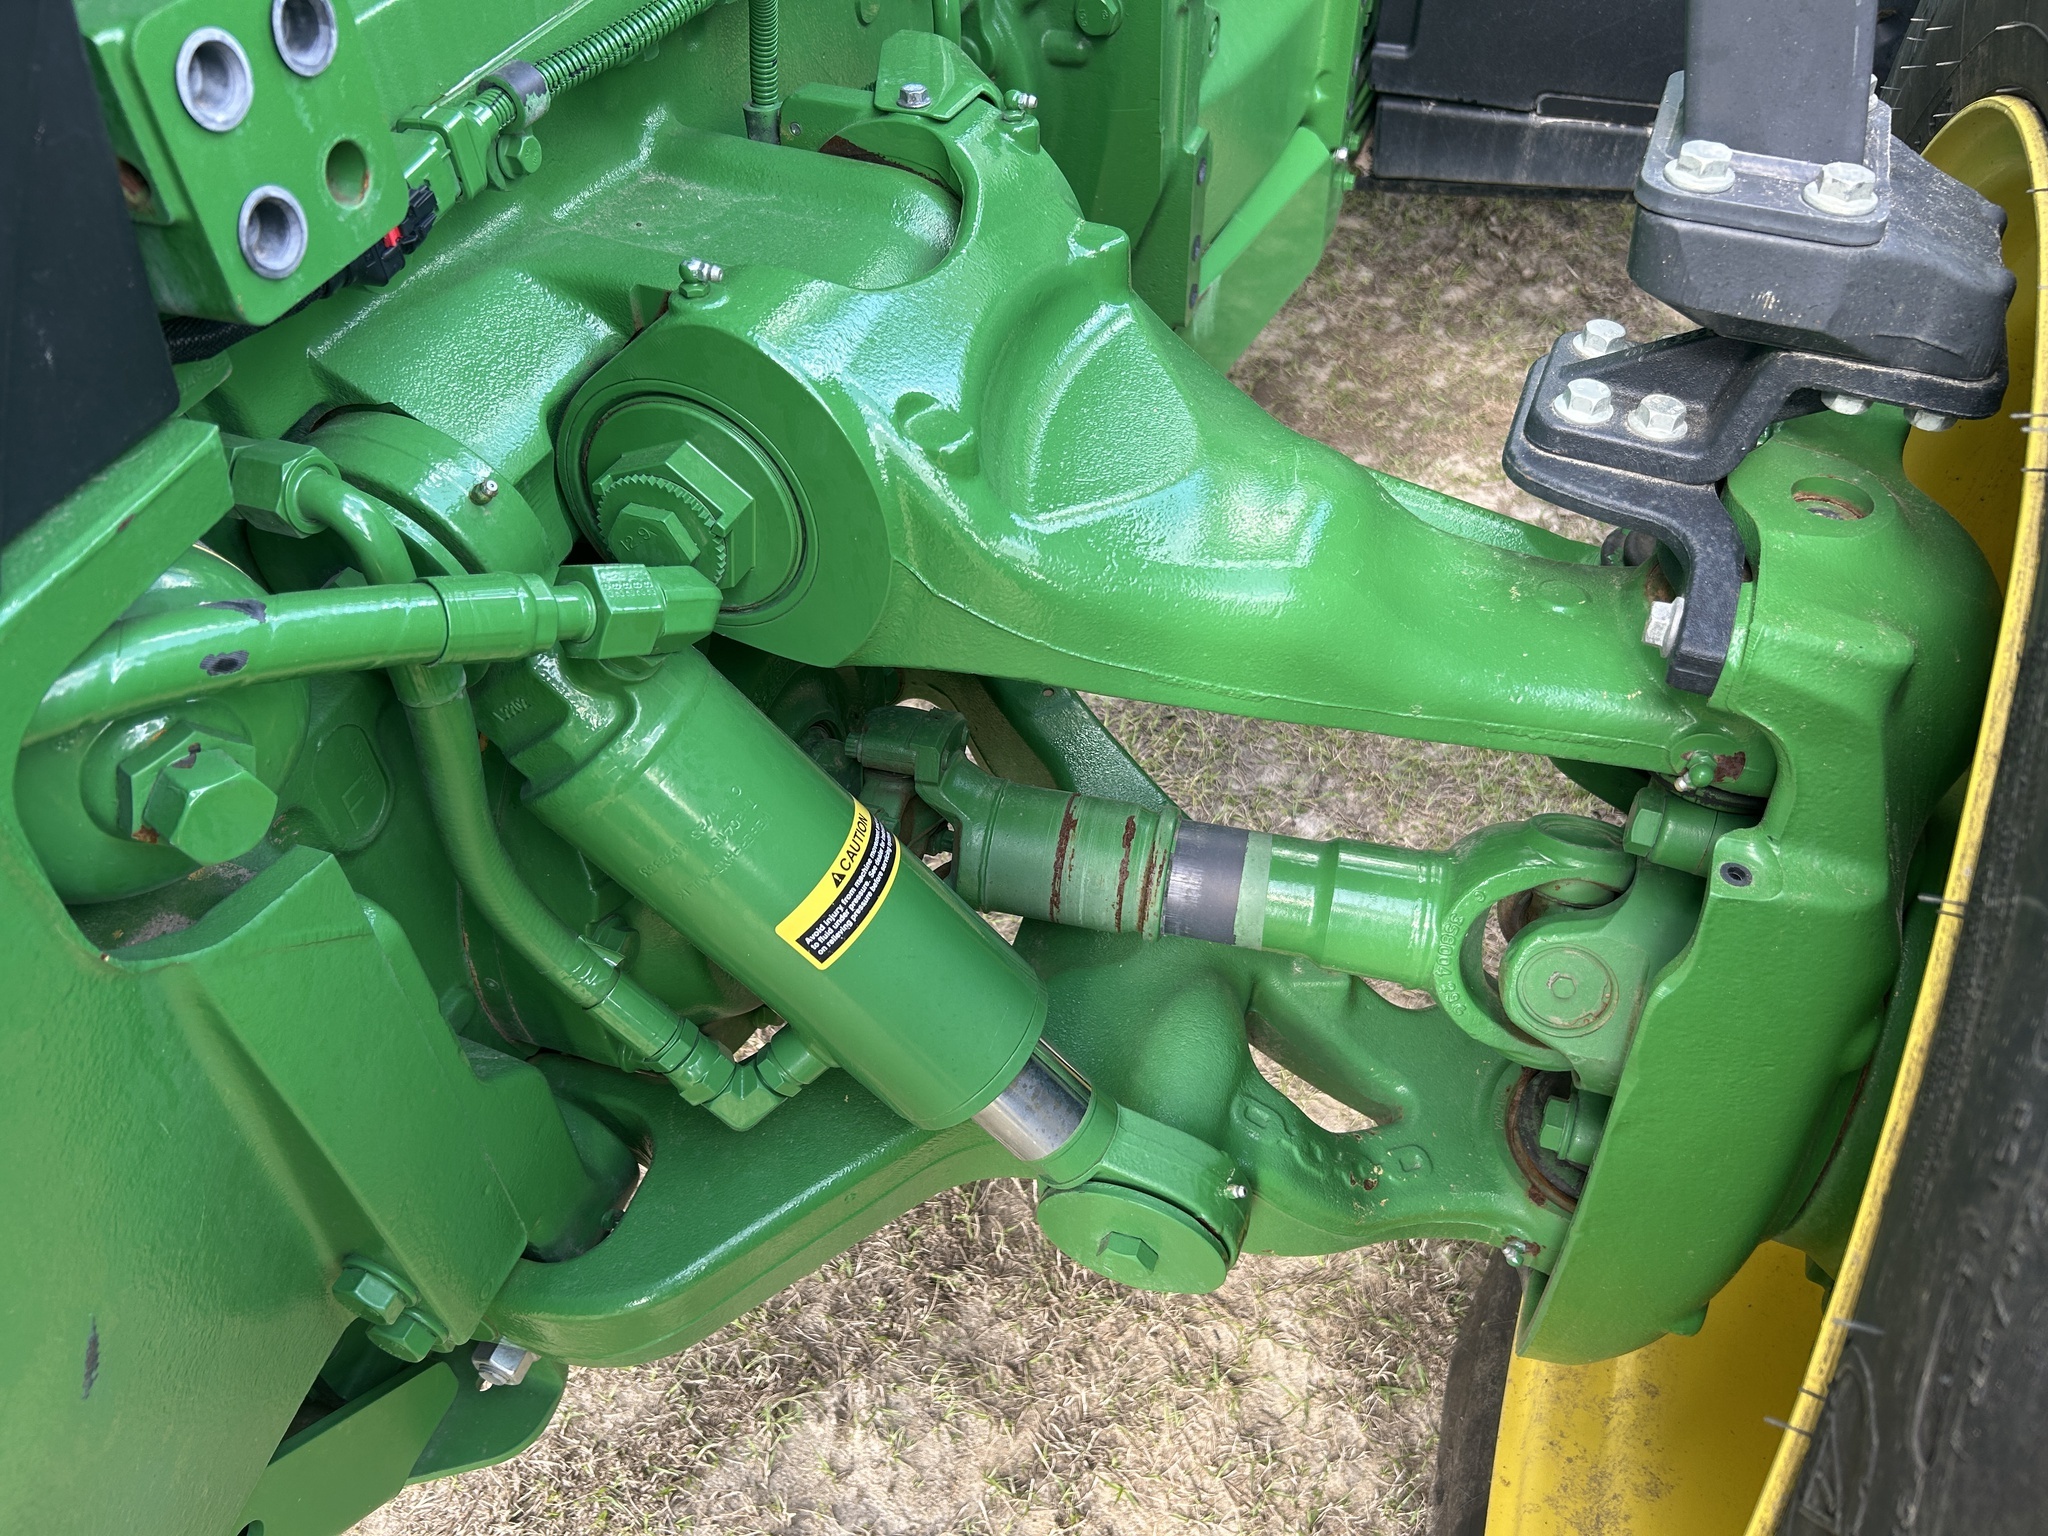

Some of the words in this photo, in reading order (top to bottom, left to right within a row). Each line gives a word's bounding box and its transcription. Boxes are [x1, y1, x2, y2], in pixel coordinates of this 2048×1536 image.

[342, 775, 365, 829] F
[840, 813, 868, 871] CAUTION
[805, 924, 826, 944] Avoid
[841, 887, 857, 905] from
[854, 858, 873, 888] machine
[810, 942, 820, 950] to
[818, 927, 834, 943] fluid
[832, 909, 850, 929] under
[848, 881, 872, 911] pressure.
[868, 865, 878, 878] See
[817, 945, 828, 955] on
[826, 919, 853, 947] relieving
[850, 887, 873, 922] pressure
[870, 871, 883, 892] before
[1434, 912, 1465, 978] 358004
